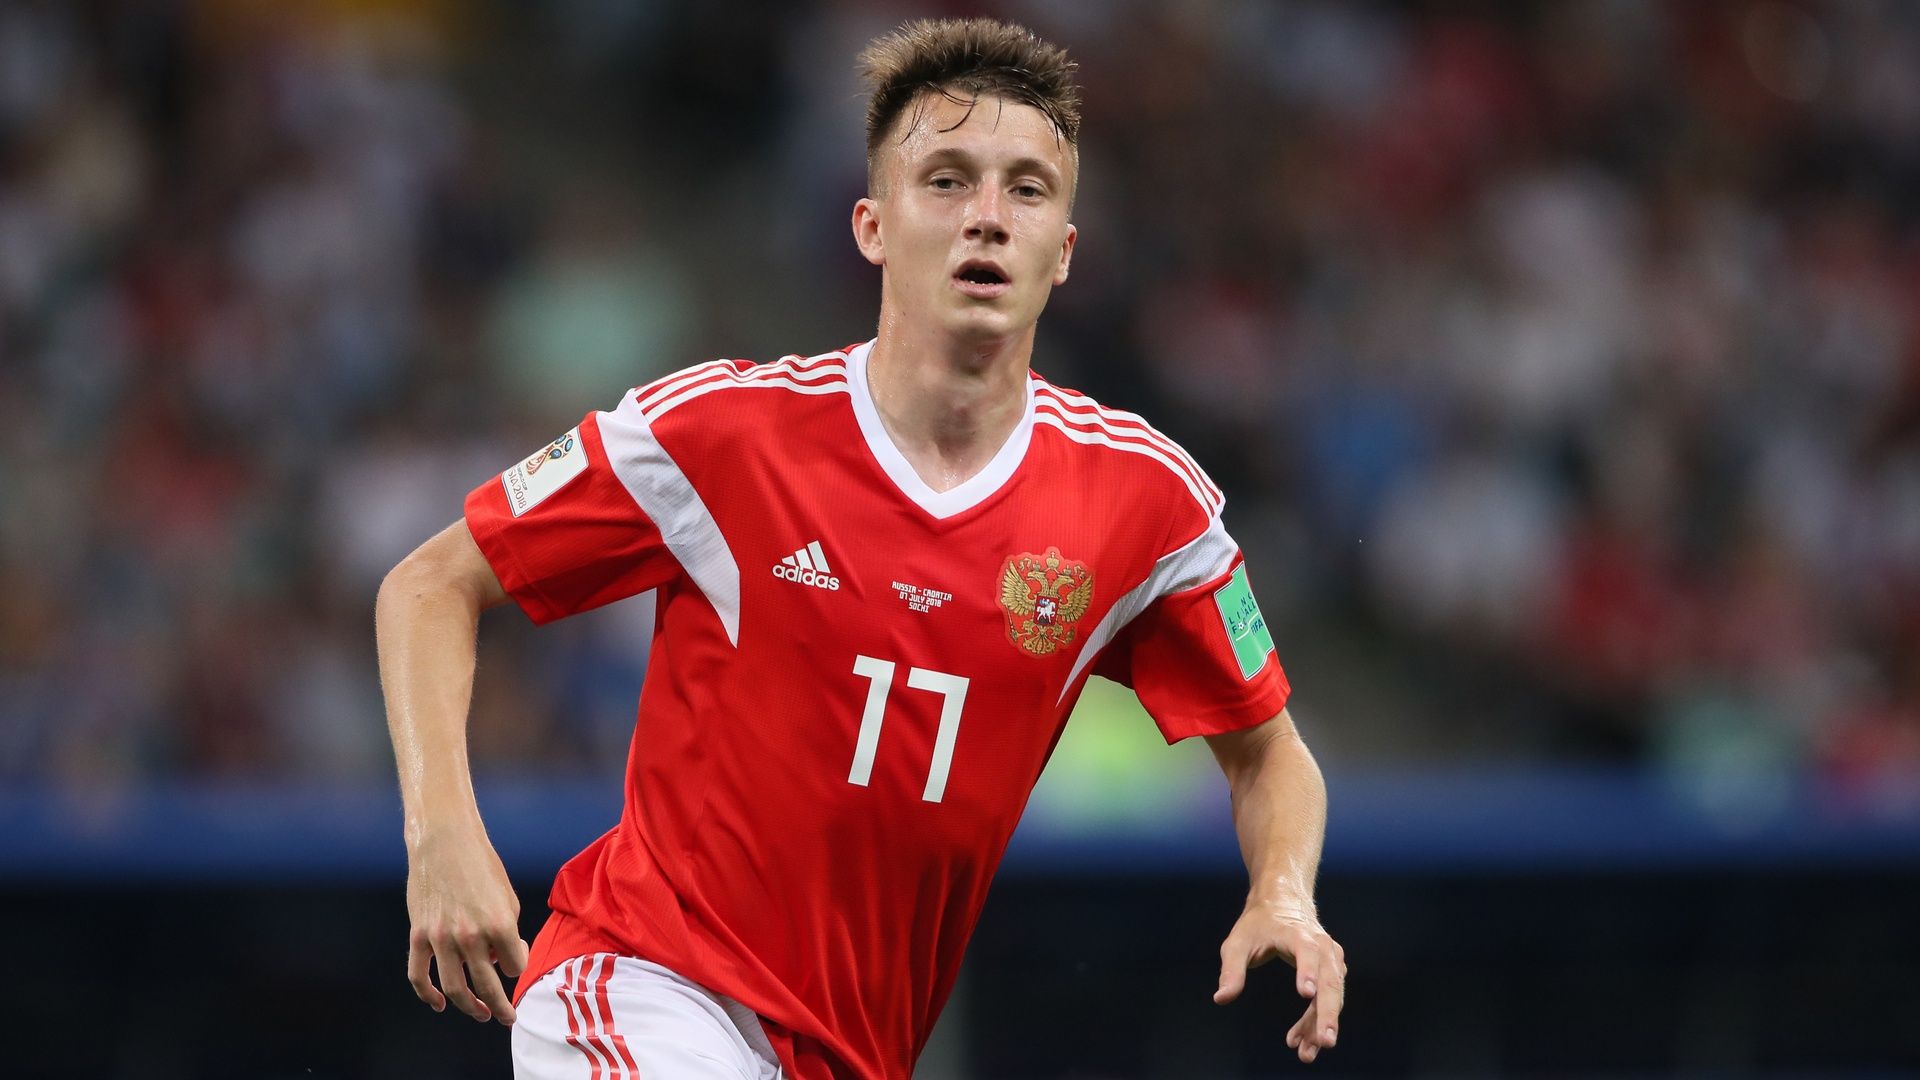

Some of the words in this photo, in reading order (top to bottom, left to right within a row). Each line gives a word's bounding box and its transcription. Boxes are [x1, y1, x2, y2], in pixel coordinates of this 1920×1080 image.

[513, 485, 526, 509] 2018
[772, 564, 840, 591] adidas
[891, 580, 917, 594] RUSSIA
[922, 588, 953, 602] CROATIA
[899, 591, 908, 600] 07
[908, 593, 925, 604] JULY
[925, 597, 942, 608] 2018
[908, 601, 930, 613] SOCHI
[847, 653, 971, 804] 17
